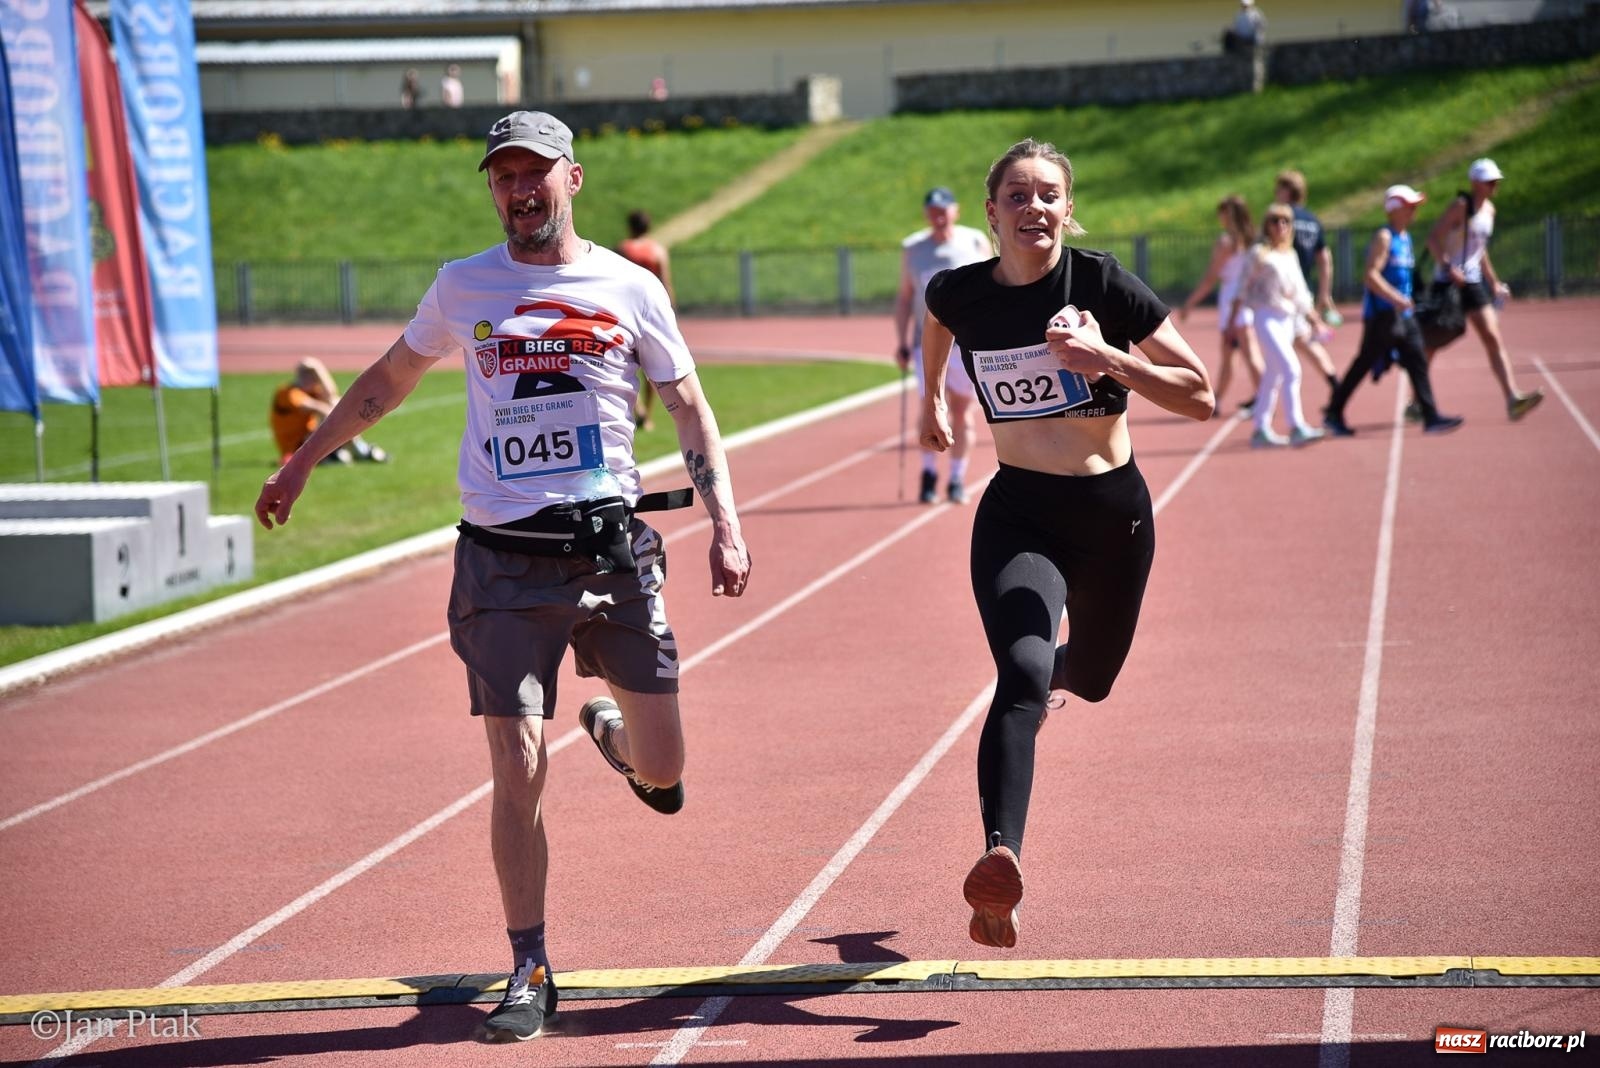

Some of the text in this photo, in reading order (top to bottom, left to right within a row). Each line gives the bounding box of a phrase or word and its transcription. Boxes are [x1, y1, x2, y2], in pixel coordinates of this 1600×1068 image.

[502, 339, 604, 356] XI BIEG BEZ
[979, 347, 1051, 364] XVIII BIEG BEZ GRANIC
[502, 355, 568, 371] GRANIC
[980, 362, 1018, 373] 3MAJA2026
[994, 375, 1059, 406] 032
[494, 399, 574, 417] XVIII BIEG BEZ GRANIC
[1064, 409, 1086, 418] NIKE
[495, 414, 536, 426] 3MAJA2026
[504, 430, 574, 466] 045
